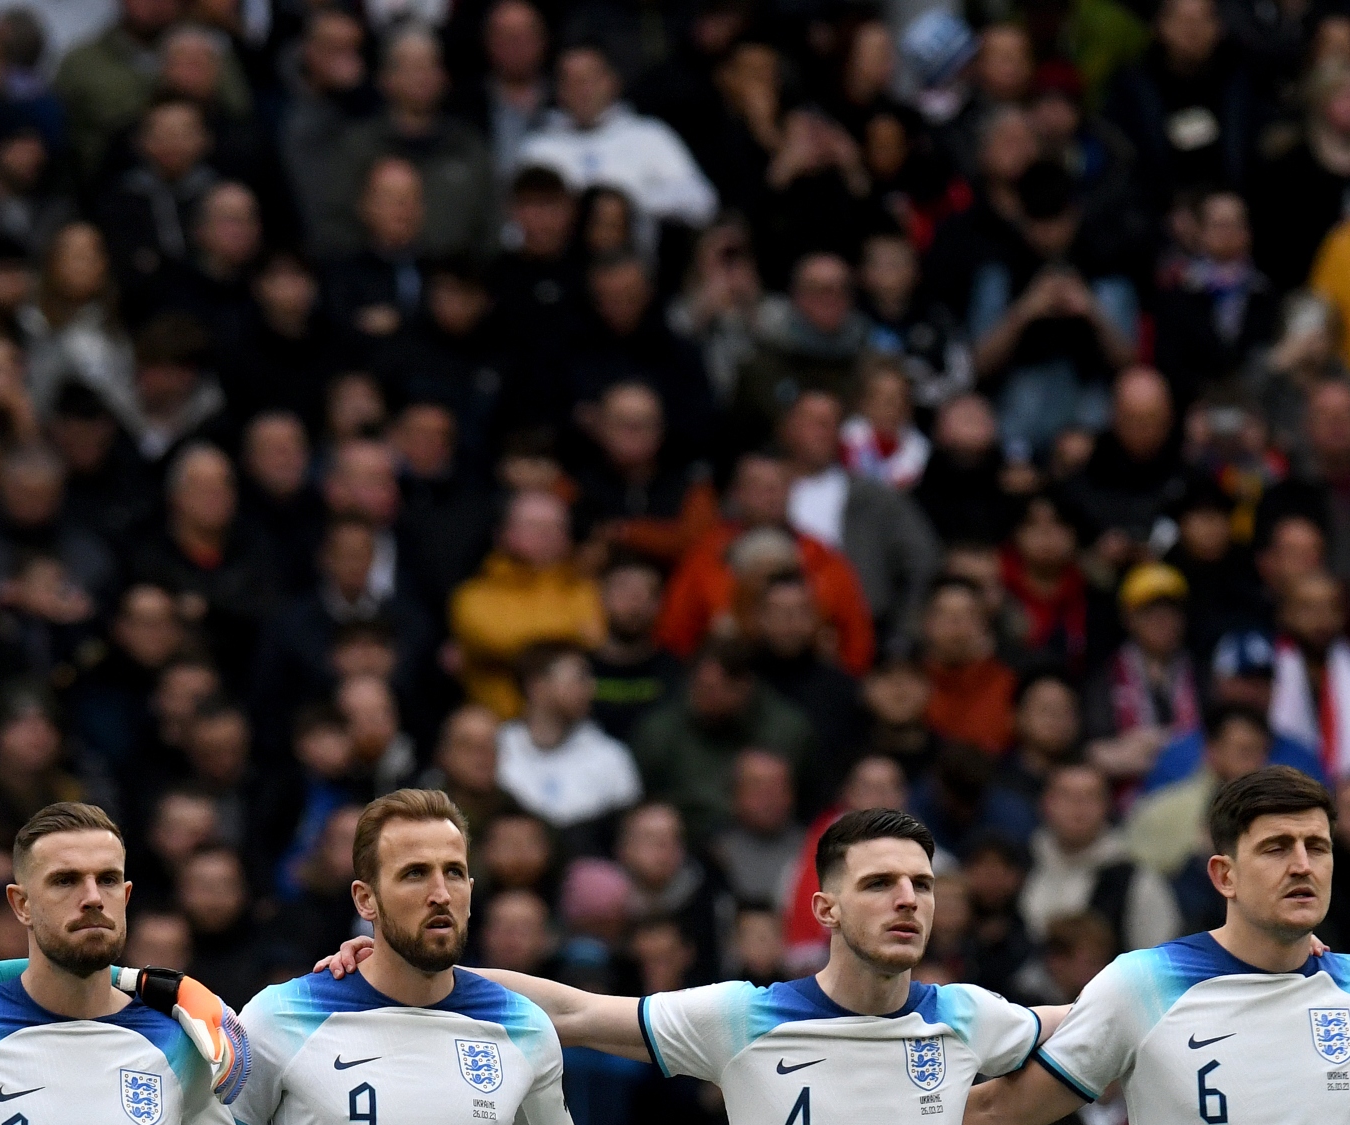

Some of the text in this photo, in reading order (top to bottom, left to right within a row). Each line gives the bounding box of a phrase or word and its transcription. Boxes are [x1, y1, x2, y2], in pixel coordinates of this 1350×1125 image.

[1197, 1059, 1229, 1125] 6
[472, 1098, 496, 1110] UKRAINE
[920, 1094, 943, 1105] UKRAINE
[472, 1109, 497, 1120] 26.03.23
